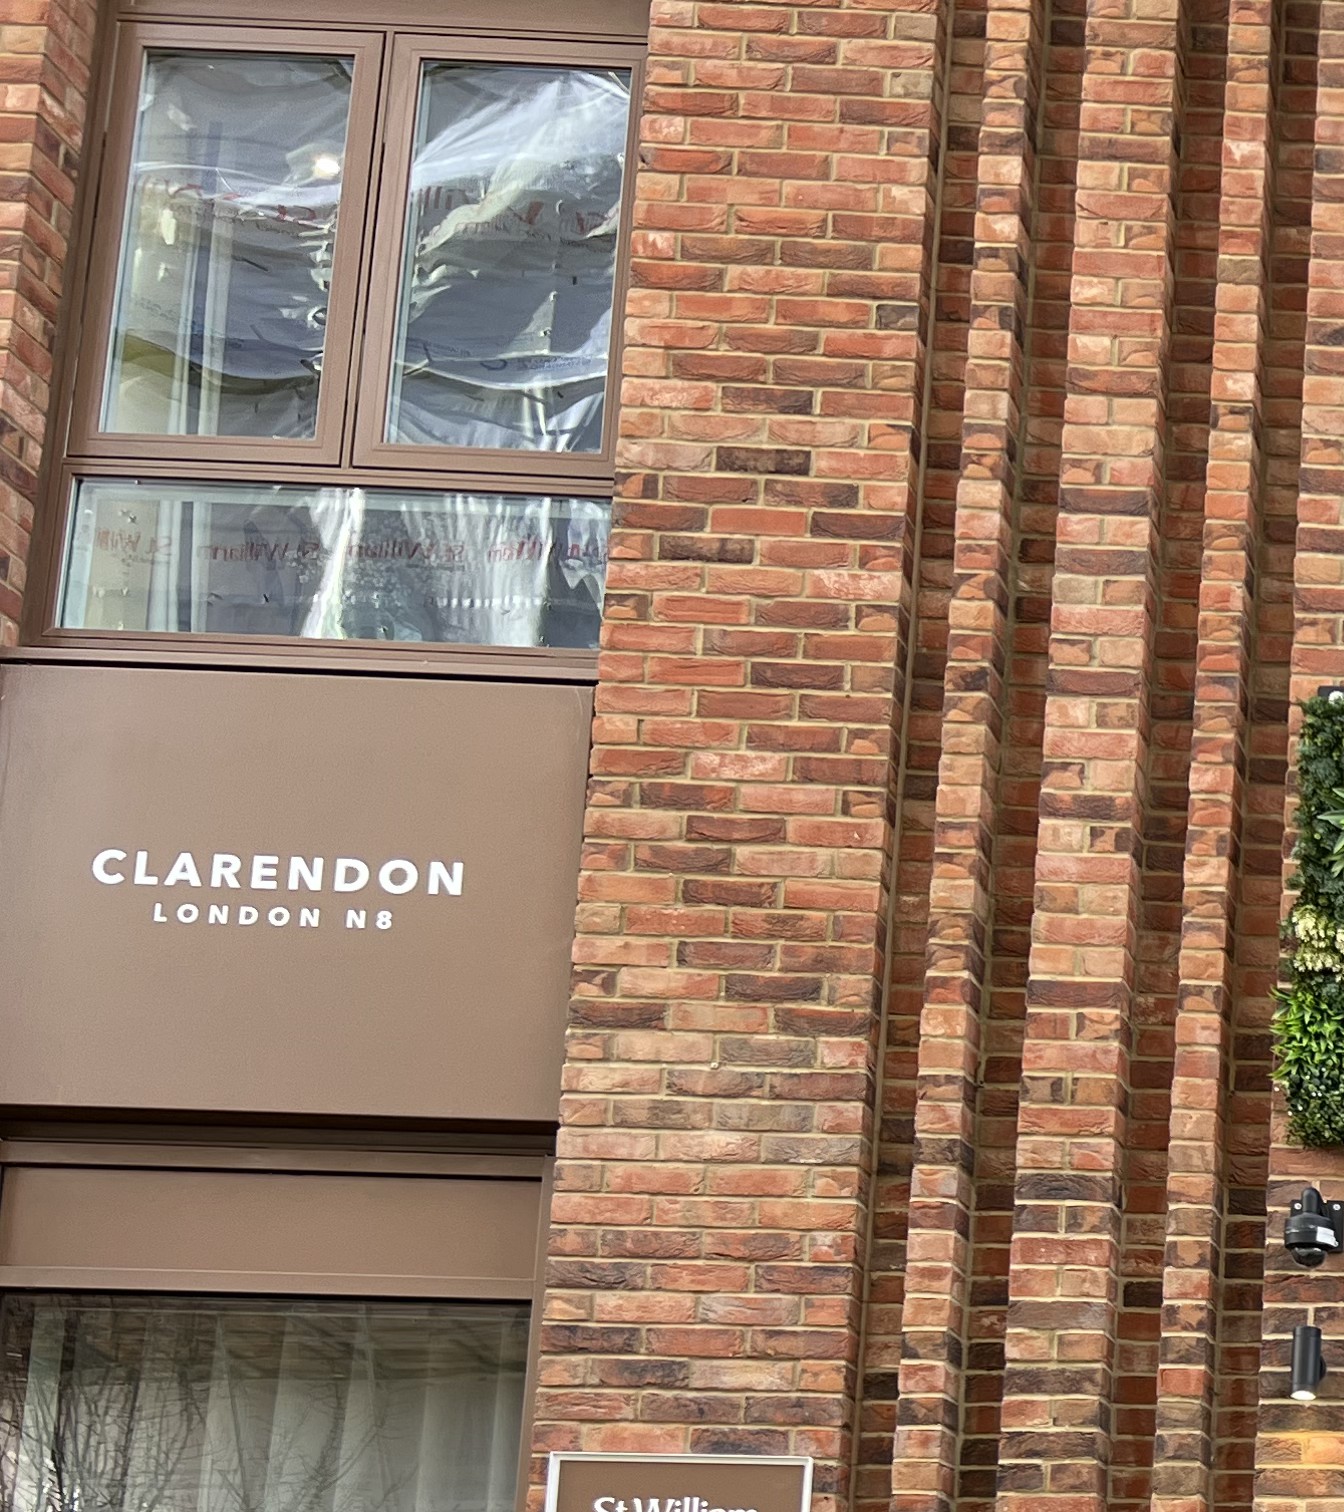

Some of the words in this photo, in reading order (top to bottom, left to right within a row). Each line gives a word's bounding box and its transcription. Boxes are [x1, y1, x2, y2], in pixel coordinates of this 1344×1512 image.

[91, 848, 465, 896] CLARENDON
[153, 903, 320, 928] LONDON
[346, 909, 393, 930] N8
